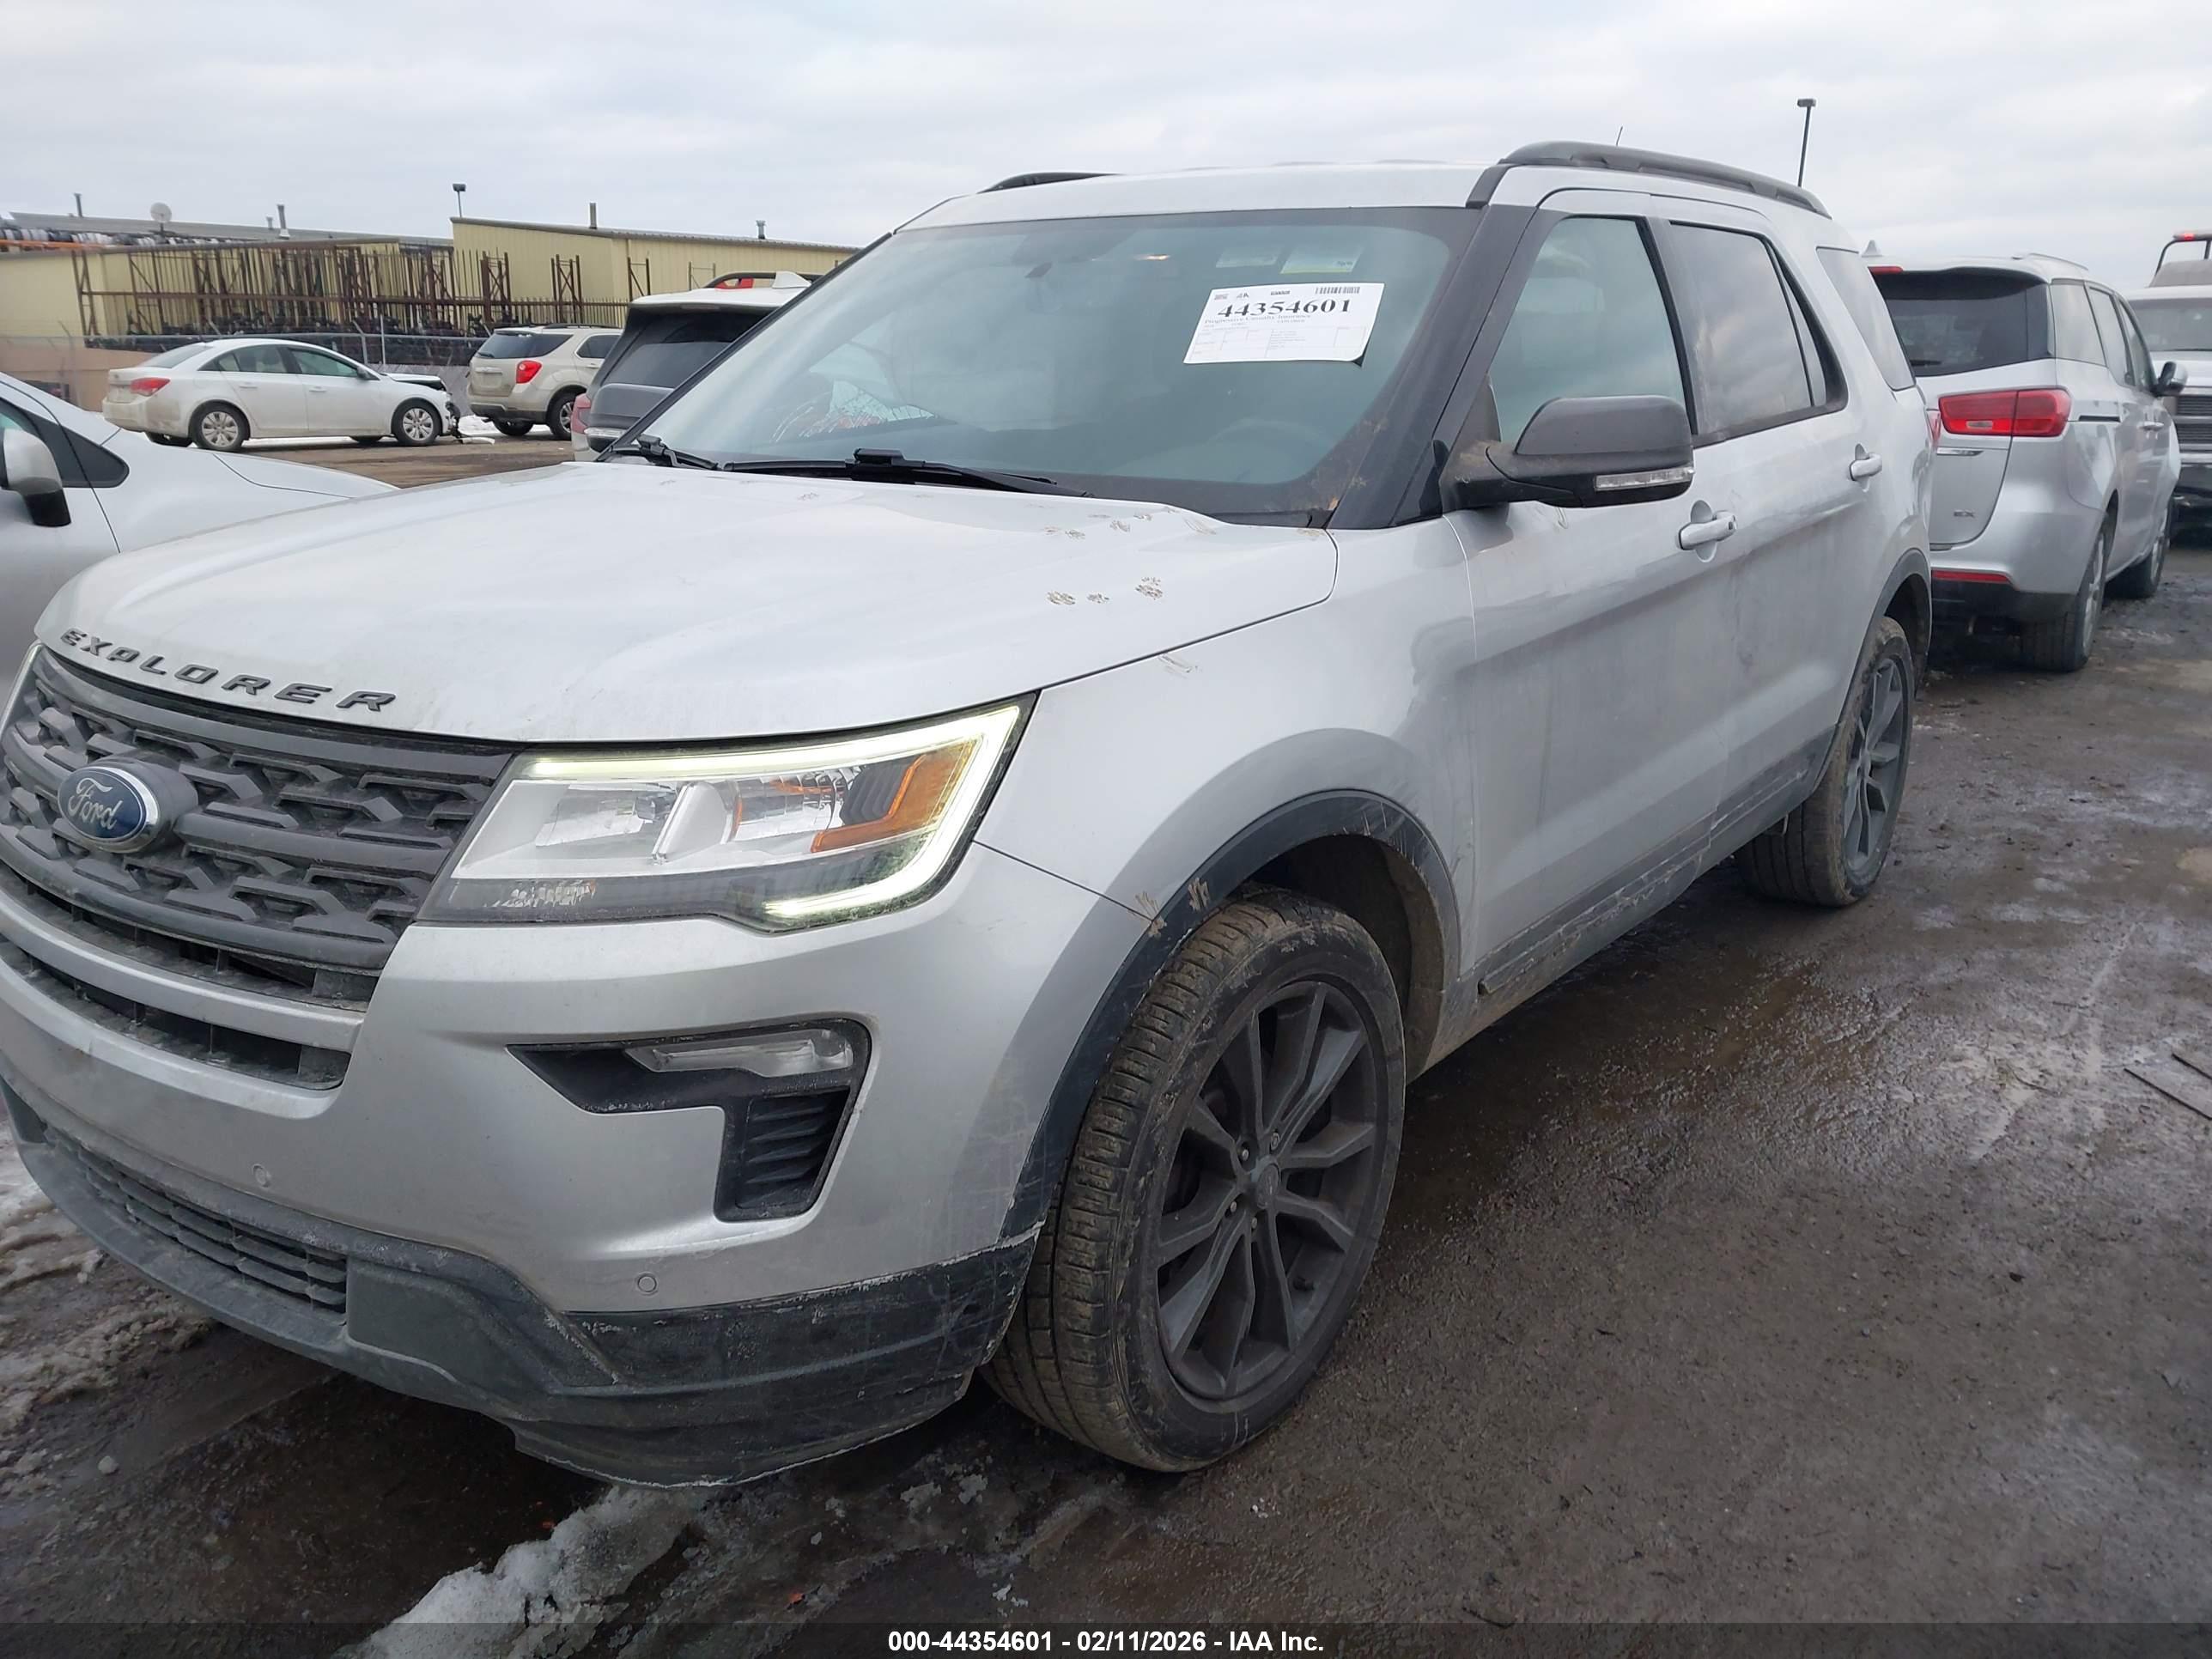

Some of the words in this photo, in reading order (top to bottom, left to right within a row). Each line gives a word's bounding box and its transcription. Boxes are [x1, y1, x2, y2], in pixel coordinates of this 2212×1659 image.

[1218, 299, 1351, 317] 44354601
[61, 628, 396, 712] EXPLORER
[68, 777, 123, 830] Ford
